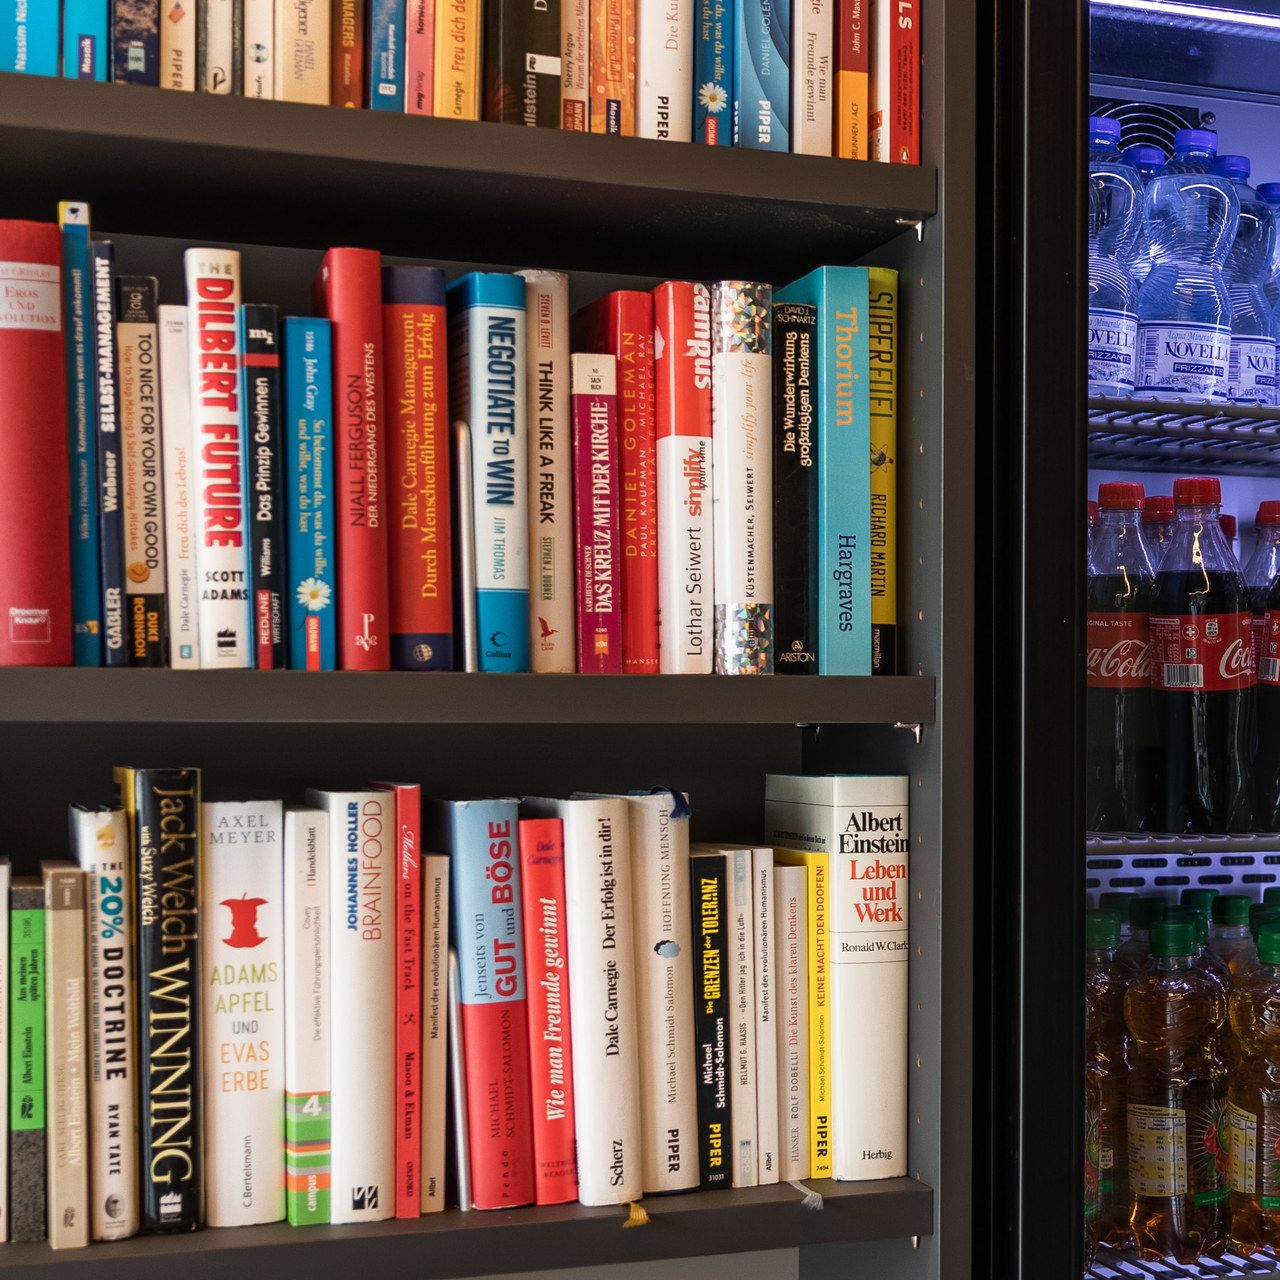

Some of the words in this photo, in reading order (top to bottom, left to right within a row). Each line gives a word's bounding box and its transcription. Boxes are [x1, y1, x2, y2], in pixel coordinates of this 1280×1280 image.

[761, 40, 771, 76] DANIEL
[657, 96, 670, 139] PIPER
[758, 101, 770, 144] PIPER
[97, 258, 116, 432] SELBST-MANAGEMENT
[196, 278, 238, 413] DILBERT
[686, 284, 711, 389] campus
[486, 316, 516, 436] NEGOTIATE
[538, 361, 554, 411] THINK
[836, 307, 857, 426] Thorium
[1175, 364, 1223, 376] FRIZZANTE
[256, 378, 270, 441] Gewinnen
[347, 375, 362, 475] FERGUSON
[539, 415, 554, 450] LIKE
[257, 444, 271, 496] Prinzip
[501, 439, 510, 457] TO
[539, 454, 554, 468] A
[104, 451, 118, 512] Wabner
[202, 425, 242, 548] FUTURE
[348, 478, 365, 527] NIALL
[485, 459, 514, 506] WIN
[541, 472, 555, 523] FREAK
[684, 449, 702, 517] simplify
[257, 499, 270, 521] Das
[204, 571, 244, 582] SCOTT
[686, 527, 701, 591] Seiwert
[202, 589, 249, 600] ADAMS
[833, 534, 856, 632] Hargraves
[105, 588, 122, 648] GABLER
[133, 598, 145, 657] ROBINSON
[146, 612, 158, 642] DUKE
[686, 594, 703, 656] Lothar
[779, 652, 814, 663] ARISTON
[152, 785, 195, 854] Jack
[209, 831, 277, 844] MEYER
[218, 815, 270, 828] AXEL
[347, 802, 357, 854] HOLLER
[845, 812, 903, 833] Albert
[486, 821, 512, 904] BÖSE
[839, 835, 909, 853] Einstein
[362, 800, 383, 940] BRAINFOOD
[849, 860, 906, 879] Leben
[862, 883, 896, 901] und
[100, 875, 123, 940] 20%
[161, 857, 197, 955] Welch
[347, 858, 357, 931] JOHANNES
[702, 878, 718, 935] TOLERANZ
[854, 903, 903, 922] Werk
[475, 914, 486, 935] von
[504, 908, 514, 936] und
[474, 940, 492, 998] Jenseits
[495, 938, 517, 997] GUT
[842, 941, 874, 952] Ronald
[887, 941, 908, 951] Clark
[210, 964, 278, 985] ADAMS
[704, 950, 721, 999] GRENZEN
[104, 948, 127, 1080] DOCTRINE
[215, 993, 274, 1013] APFEL
[706, 999, 714, 1013] Die
[232, 1021, 259, 1034] UND
[148, 957, 192, 1184] WINNING
[220, 1042, 270, 1064] EVAS
[702, 1044, 712, 1085] Michael
[716, 1017, 726, 1108] Schmidt-Salomon
[221, 1071, 270, 1092] ERBE
[668, 1129, 679, 1173] PIPER
[710, 1124, 721, 1168] PIPER
[816, 1116, 827, 1157] PIPER
[862, 1149, 893, 1163] Herbig
[611, 1138, 623, 1185] Scherz
